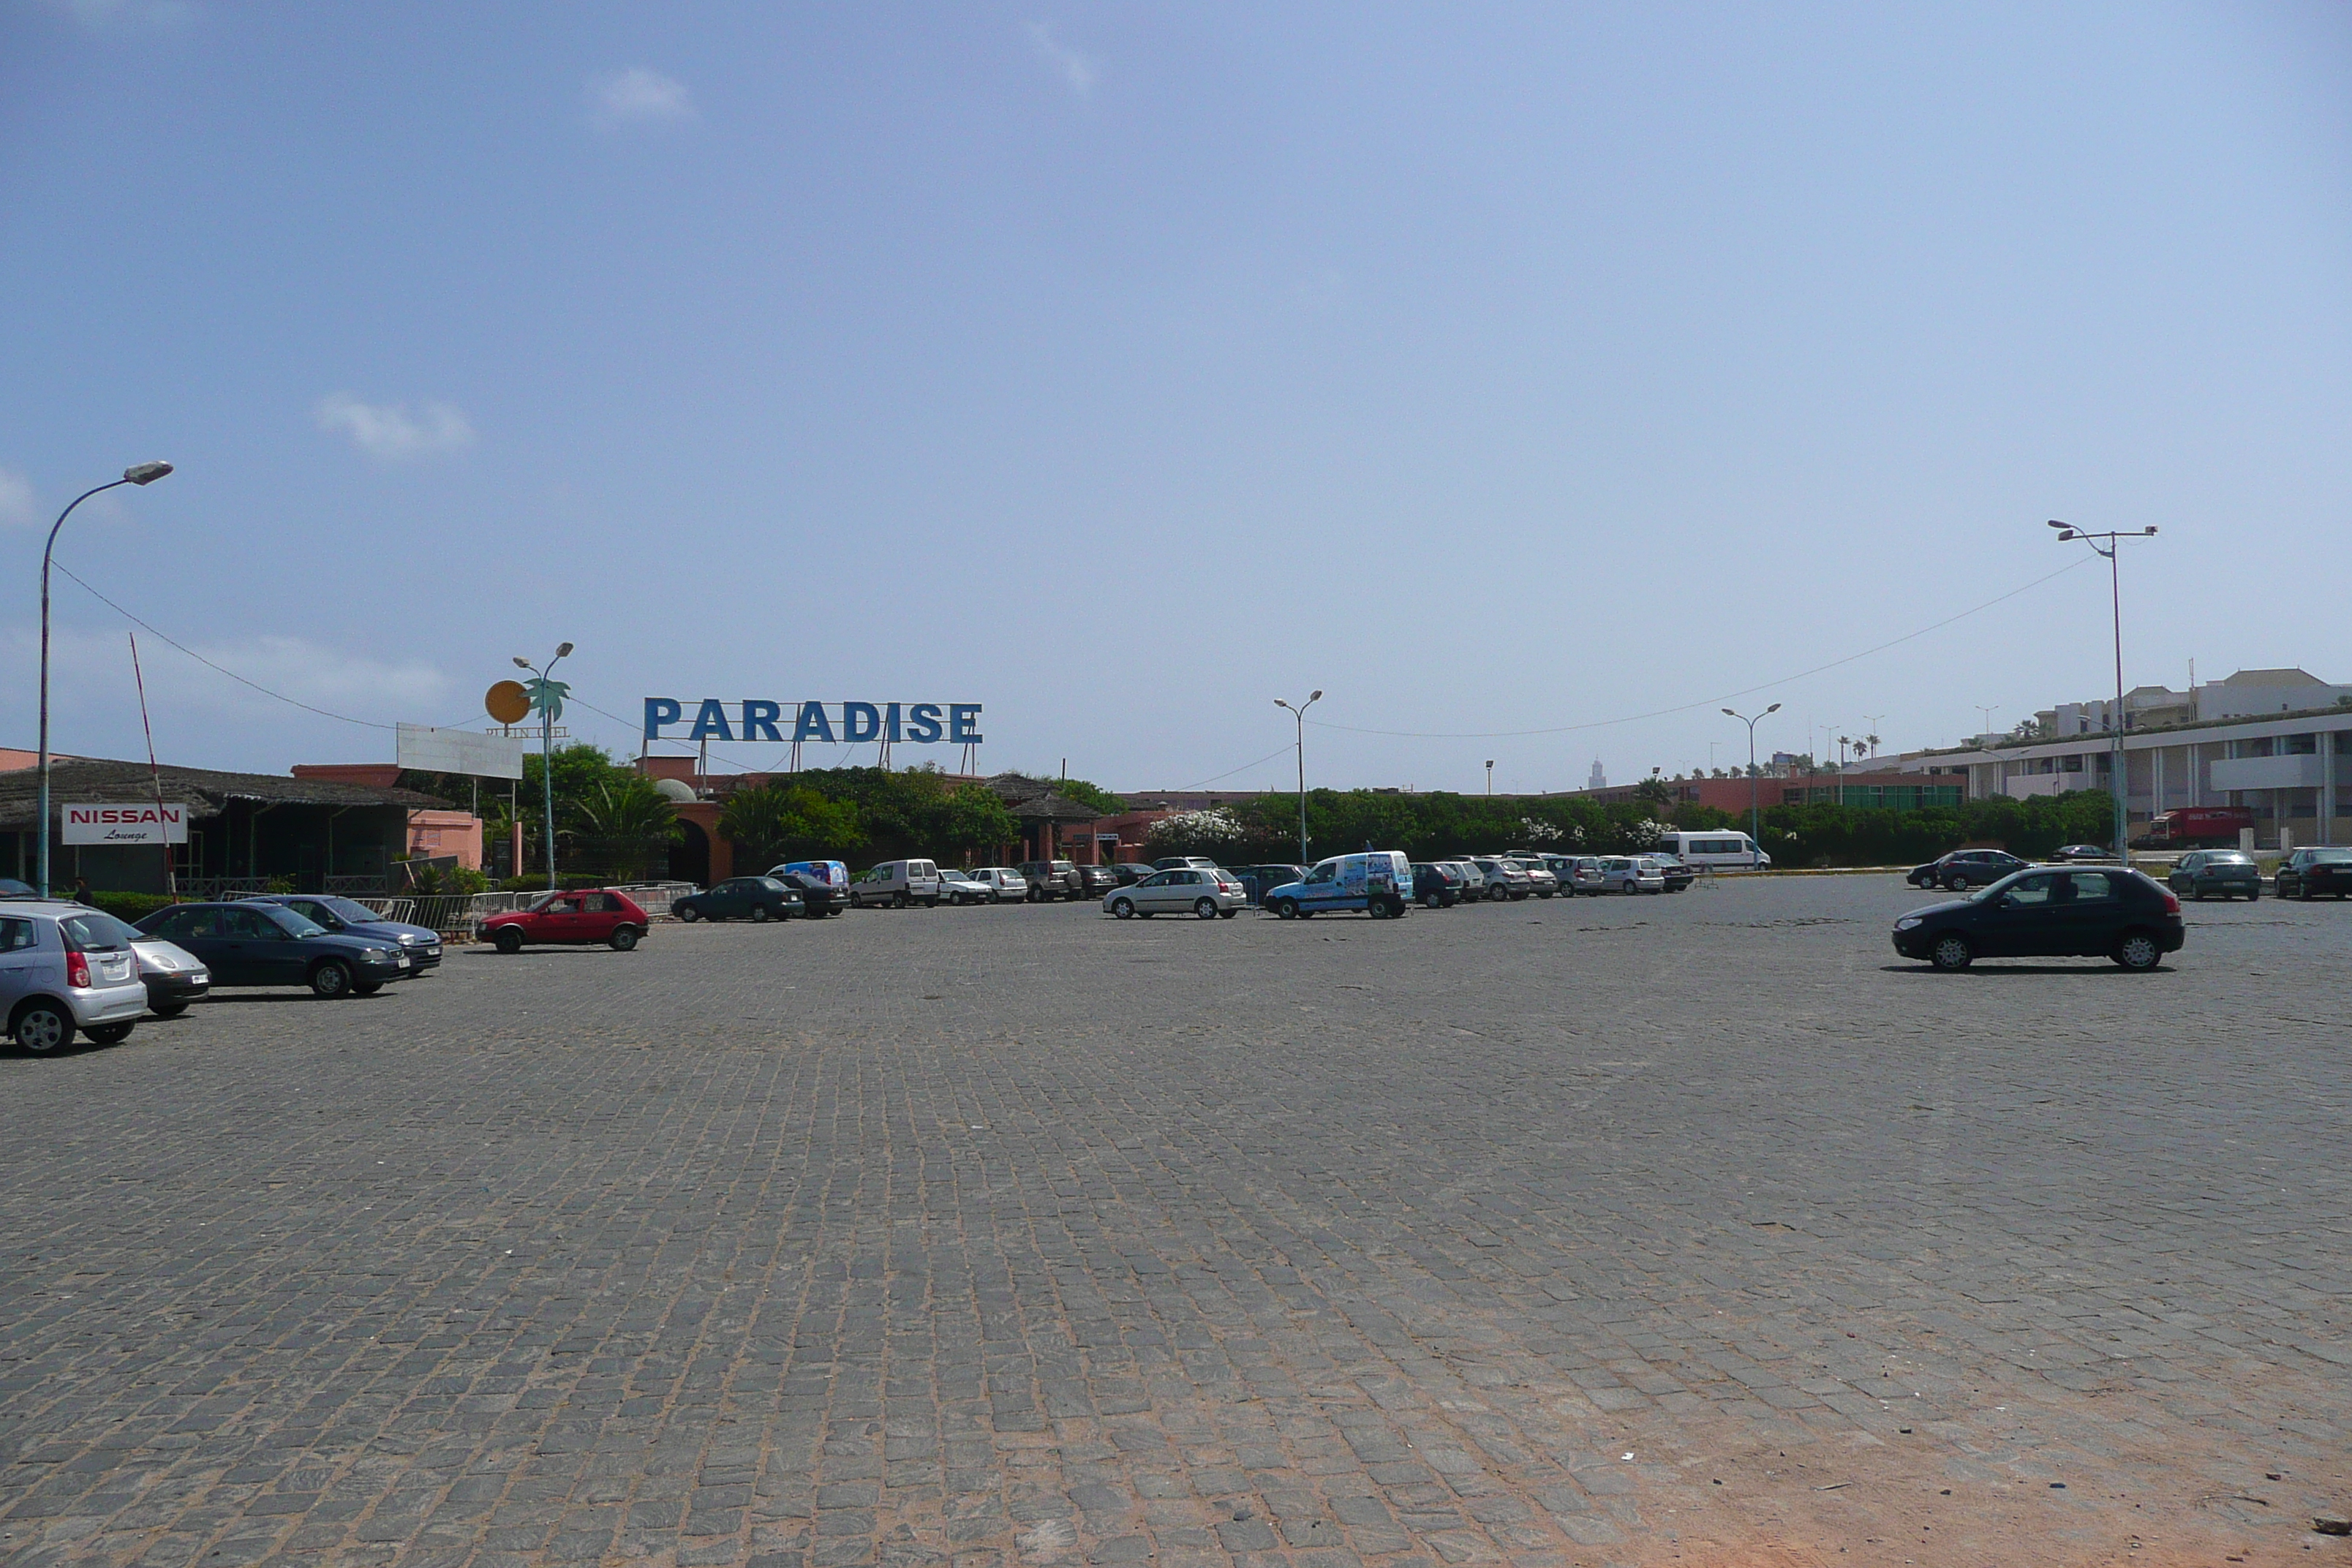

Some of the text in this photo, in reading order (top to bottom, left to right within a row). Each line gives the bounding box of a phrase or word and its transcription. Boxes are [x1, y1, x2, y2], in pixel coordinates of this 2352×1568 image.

[644, 697, 983, 744] PARADISE
[537, 726, 570, 739] CEL
[70, 810, 179, 823] NISSAN
[103, 829, 148, 842] Lounge
